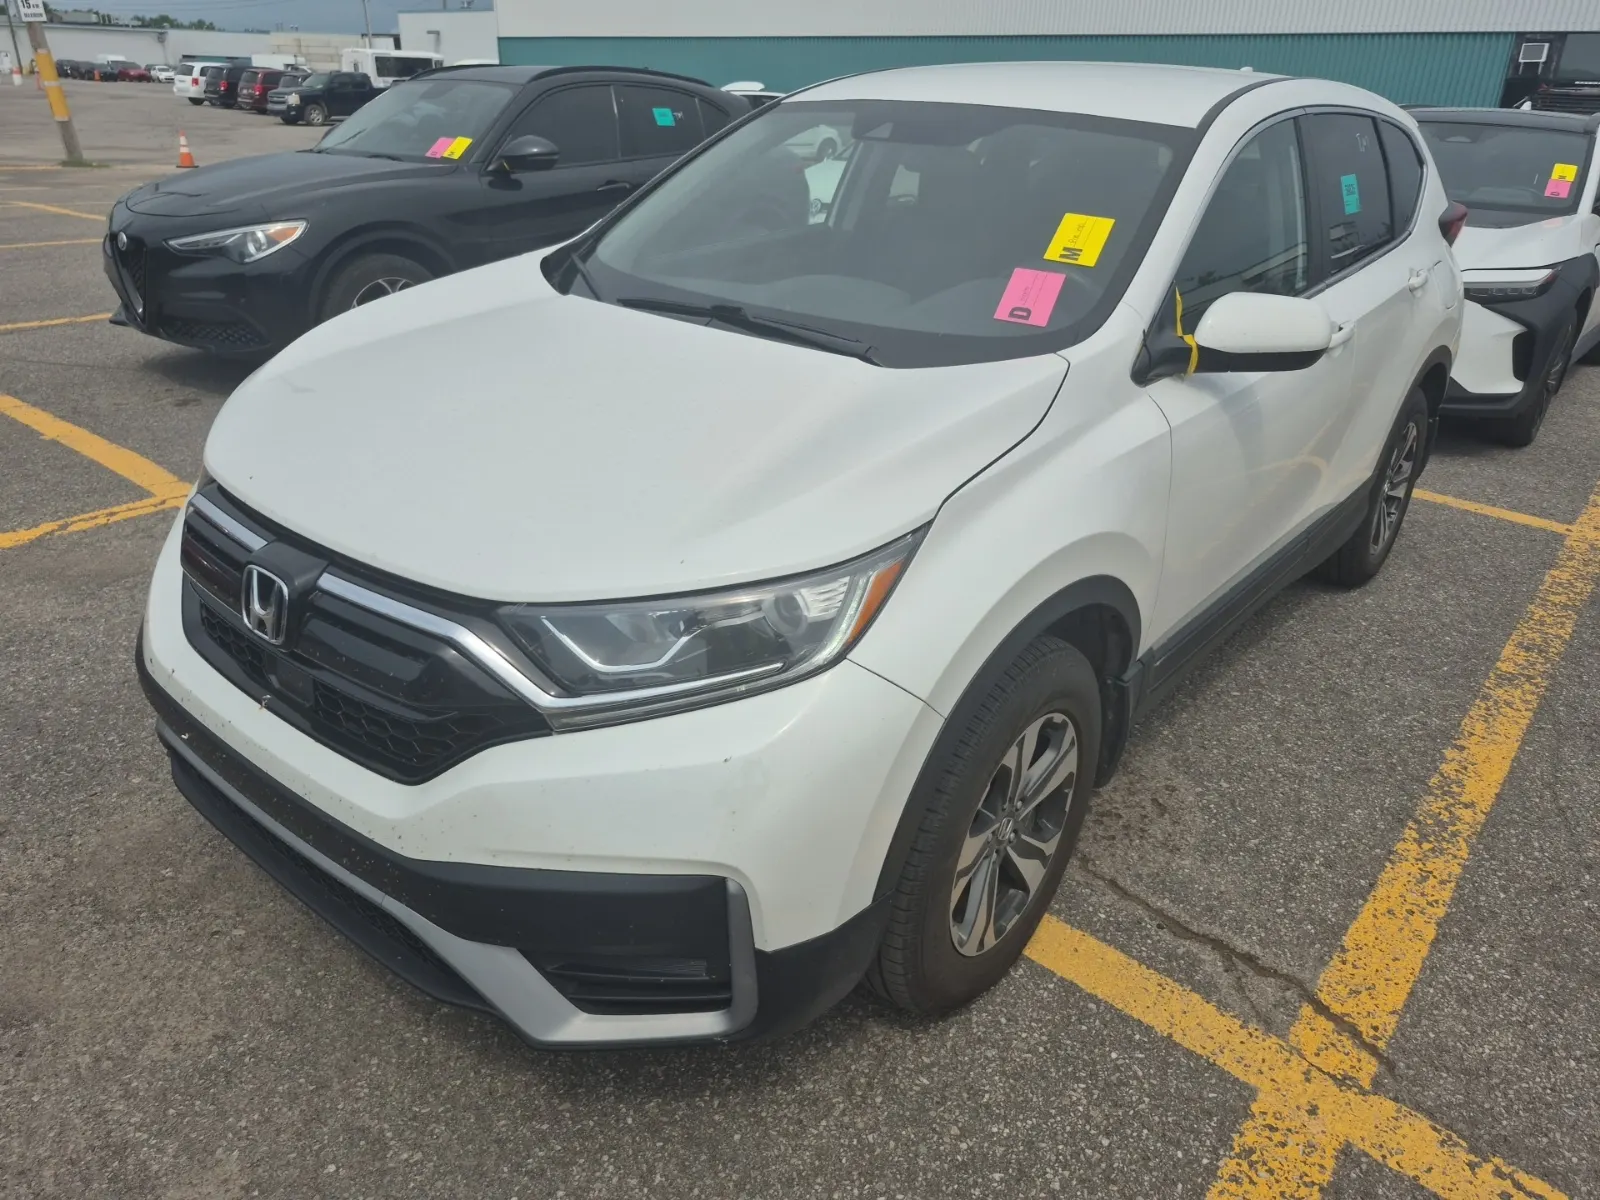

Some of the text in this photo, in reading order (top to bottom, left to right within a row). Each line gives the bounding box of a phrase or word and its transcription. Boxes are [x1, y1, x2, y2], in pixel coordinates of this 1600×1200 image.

[21, 0, 32, 9] 15
[1058, 246, 1083, 261] M
[1008, 306, 1032, 321] D
